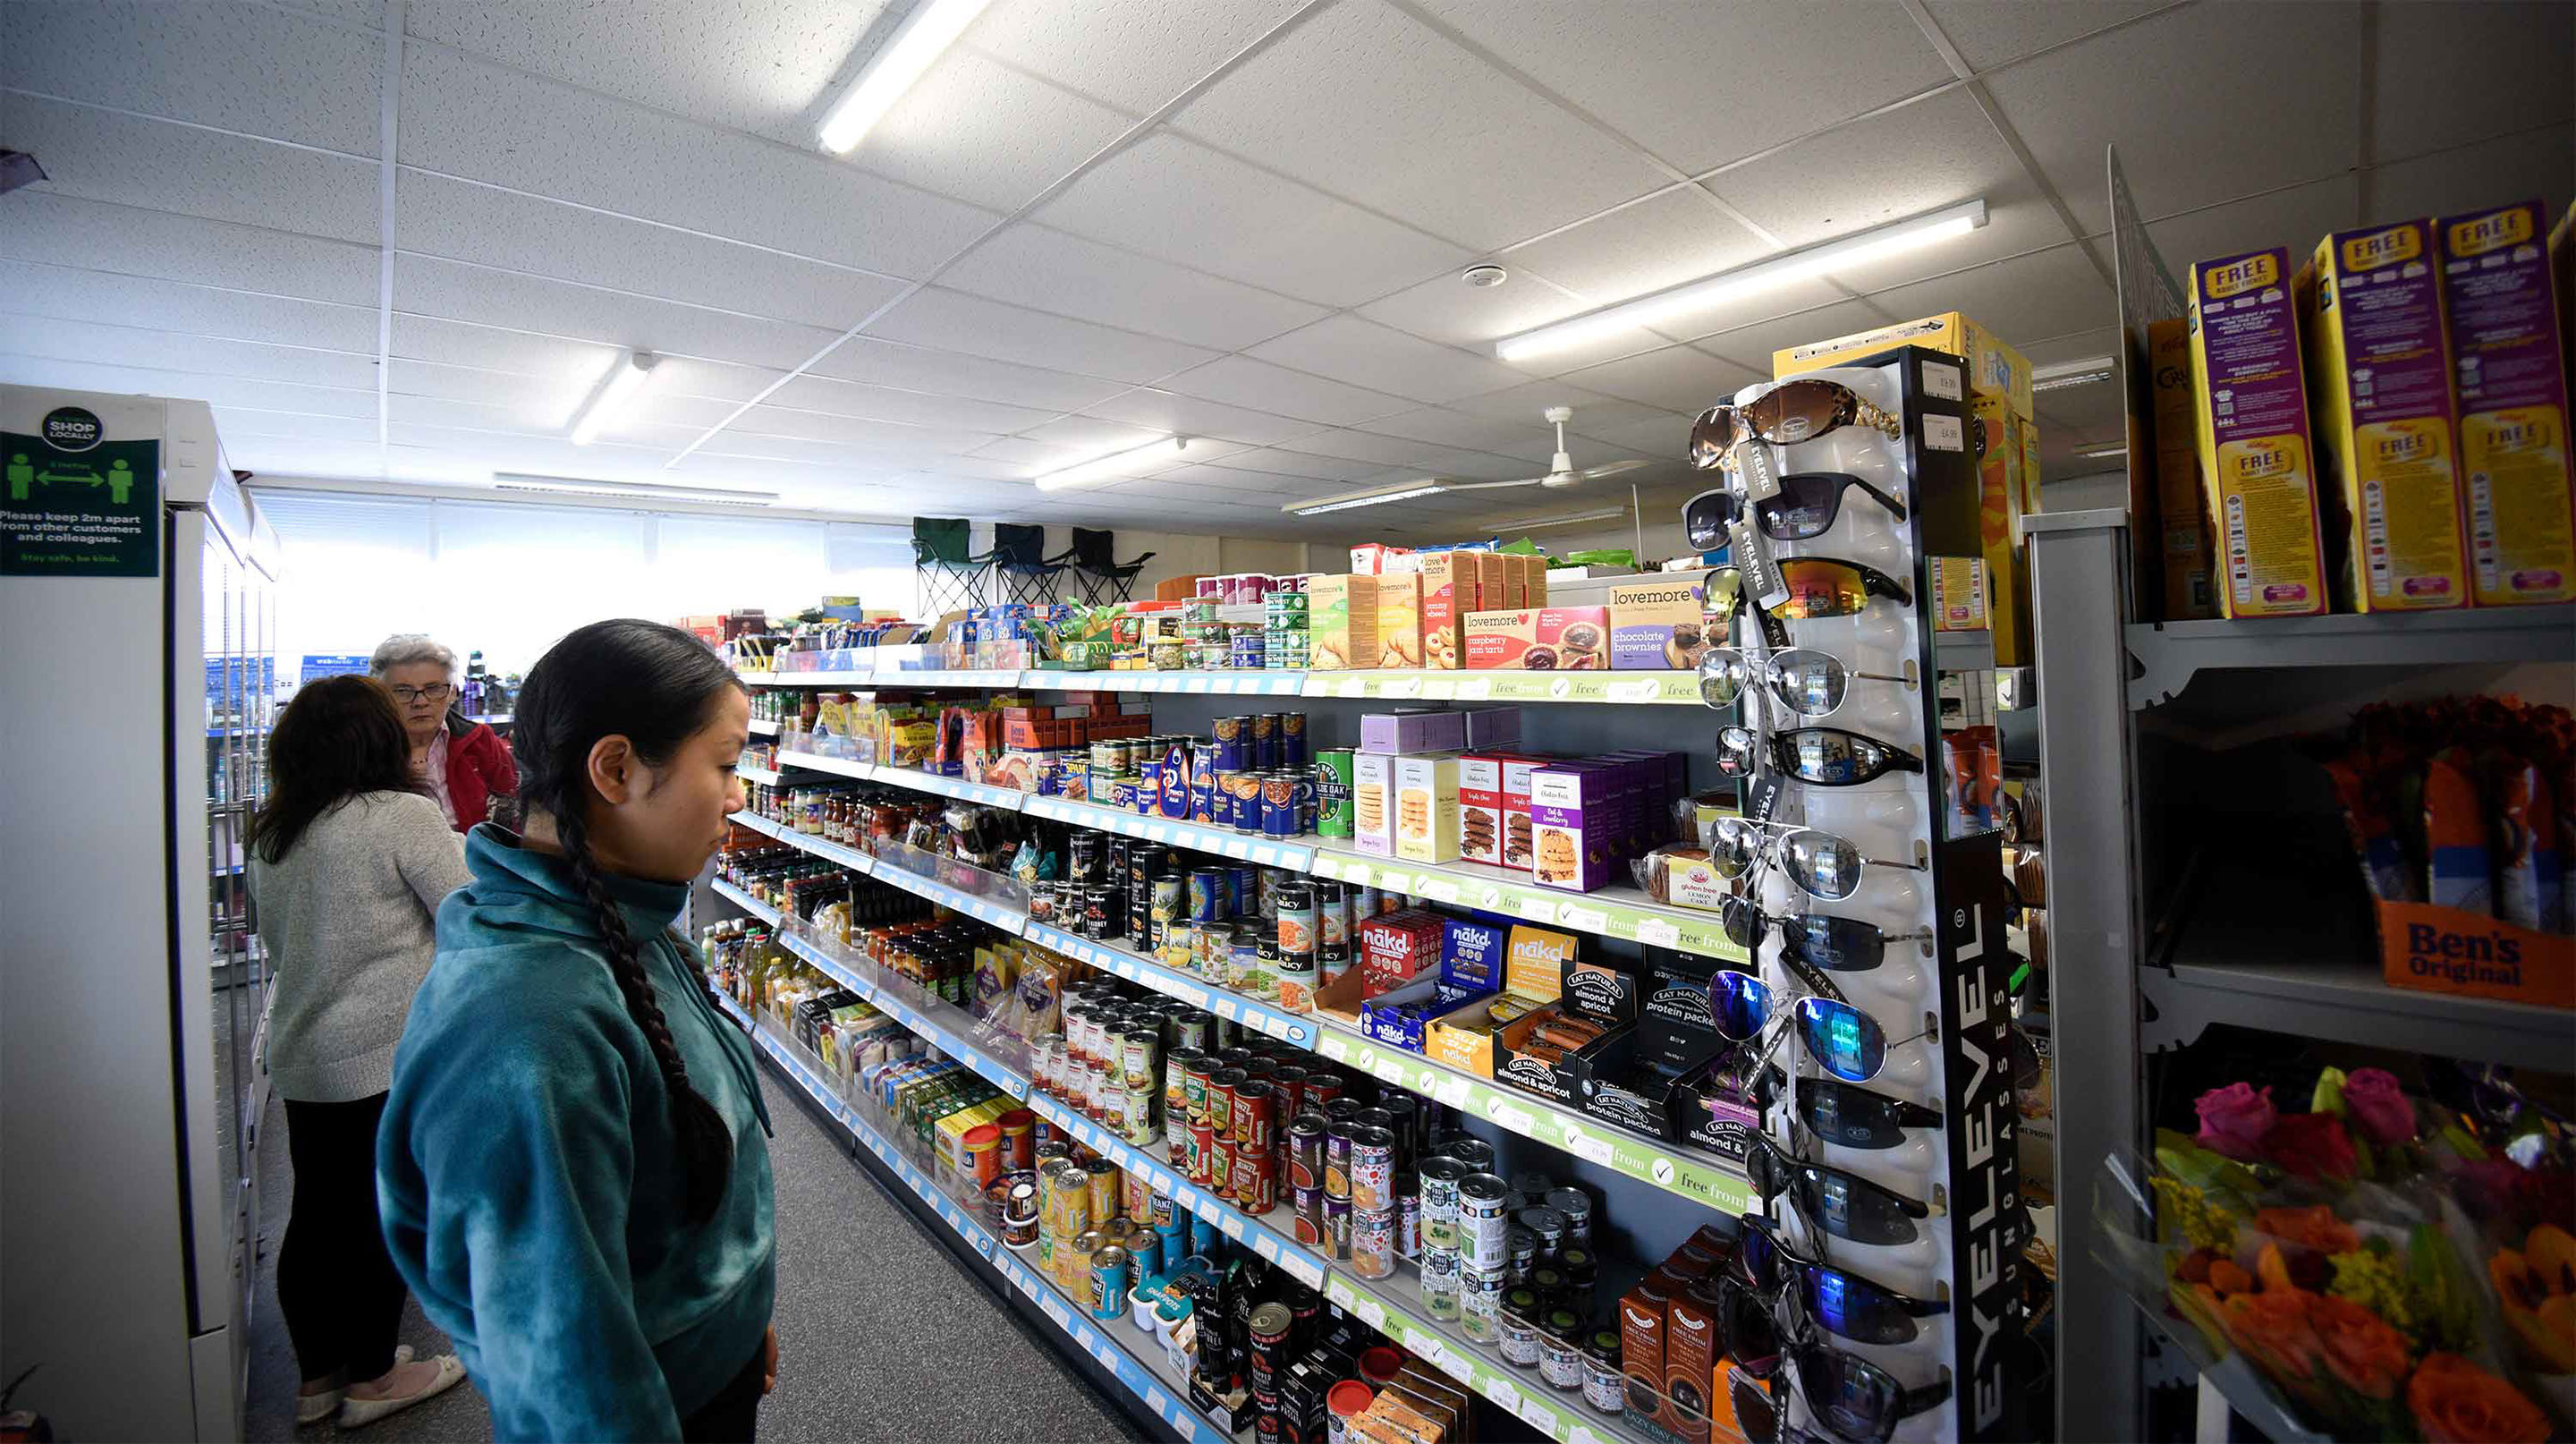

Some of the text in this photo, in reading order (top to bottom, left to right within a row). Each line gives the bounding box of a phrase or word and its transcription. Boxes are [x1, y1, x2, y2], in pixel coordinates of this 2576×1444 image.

[2353, 231, 2407, 258] FREE
[2216, 259, 2267, 285] FREE
[50, 421, 96, 432] SHOP
[50, 431, 96, 440] LOCALLY
[1751, 446, 1771, 492] EYELEVEL
[2240, 450, 2284, 470] FREE
[0, 511, 141, 526] Please keep 2m apart
[34, 522, 70, 531] other
[72, 524, 142, 534] customers
[18, 532, 123, 545] and colleagues.
[1425, 556, 1441, 565] love
[1742, 530, 1766, 591] EYELEVEL
[1425, 566, 1446, 575] more
[1614, 589, 1690, 605] lovemore
[1468, 615, 1518, 628] lovemore
[1469, 635, 1507, 647] raspberry
[1614, 631, 1665, 642] chocolate
[1469, 646, 1504, 655] jam tarts
[1614, 641, 1663, 653] brownies
[1576, 683, 1599, 695] free
[1667, 684, 1694, 696] free
[1066, 761, 1087, 774] SPAM
[1317, 784, 1345, 794] LDE OAK
[1681, 884, 1701, 894] gluten
[1682, 891, 1711, 900] LEMON
[1679, 928, 1701, 945] ree
[1703, 929, 1738, 953] from
[2408, 922, 2521, 964] Ben's
[2409, 955, 2521, 986] Original
[1572, 973, 1621, 996] EAT NATURAL
[1574, 989, 1615, 1007] almond &
[1580, 999, 1612, 1015] apricot
[1658, 990, 1710, 1010] EAT NATURA
[1646, 1001, 1716, 1027] protein packe
[1512, 1061, 1523, 1070] EAT
[1523, 1060, 1554, 1081] NATURAL
[1497, 1067, 1530, 1086] almond
[1530, 1077, 1538, 1088] &
[1538, 1081, 1572, 1100] apricot
[1599, 1096, 1645, 1121] EAT NATURAL
[1586, 1101, 1662, 1136] protein packed
[1710, 1122, 1724, 1132] EAT
[1690, 1129, 1743, 1155] almond &
[1614, 1149, 1646, 1171] from
[1994, 989, 2018, 1316] SUNGLASSES
[1681, 1172, 1744, 1209] free from
[1154, 1199, 1172, 1209] EANZ
[1385, 1315, 1402, 1335] free
[1625, 1324, 1657, 1345] FREE FROM
[1673, 1326, 1707, 1347] FREE FROM
[1624, 1408, 1670, 1441] LAZY DAY
